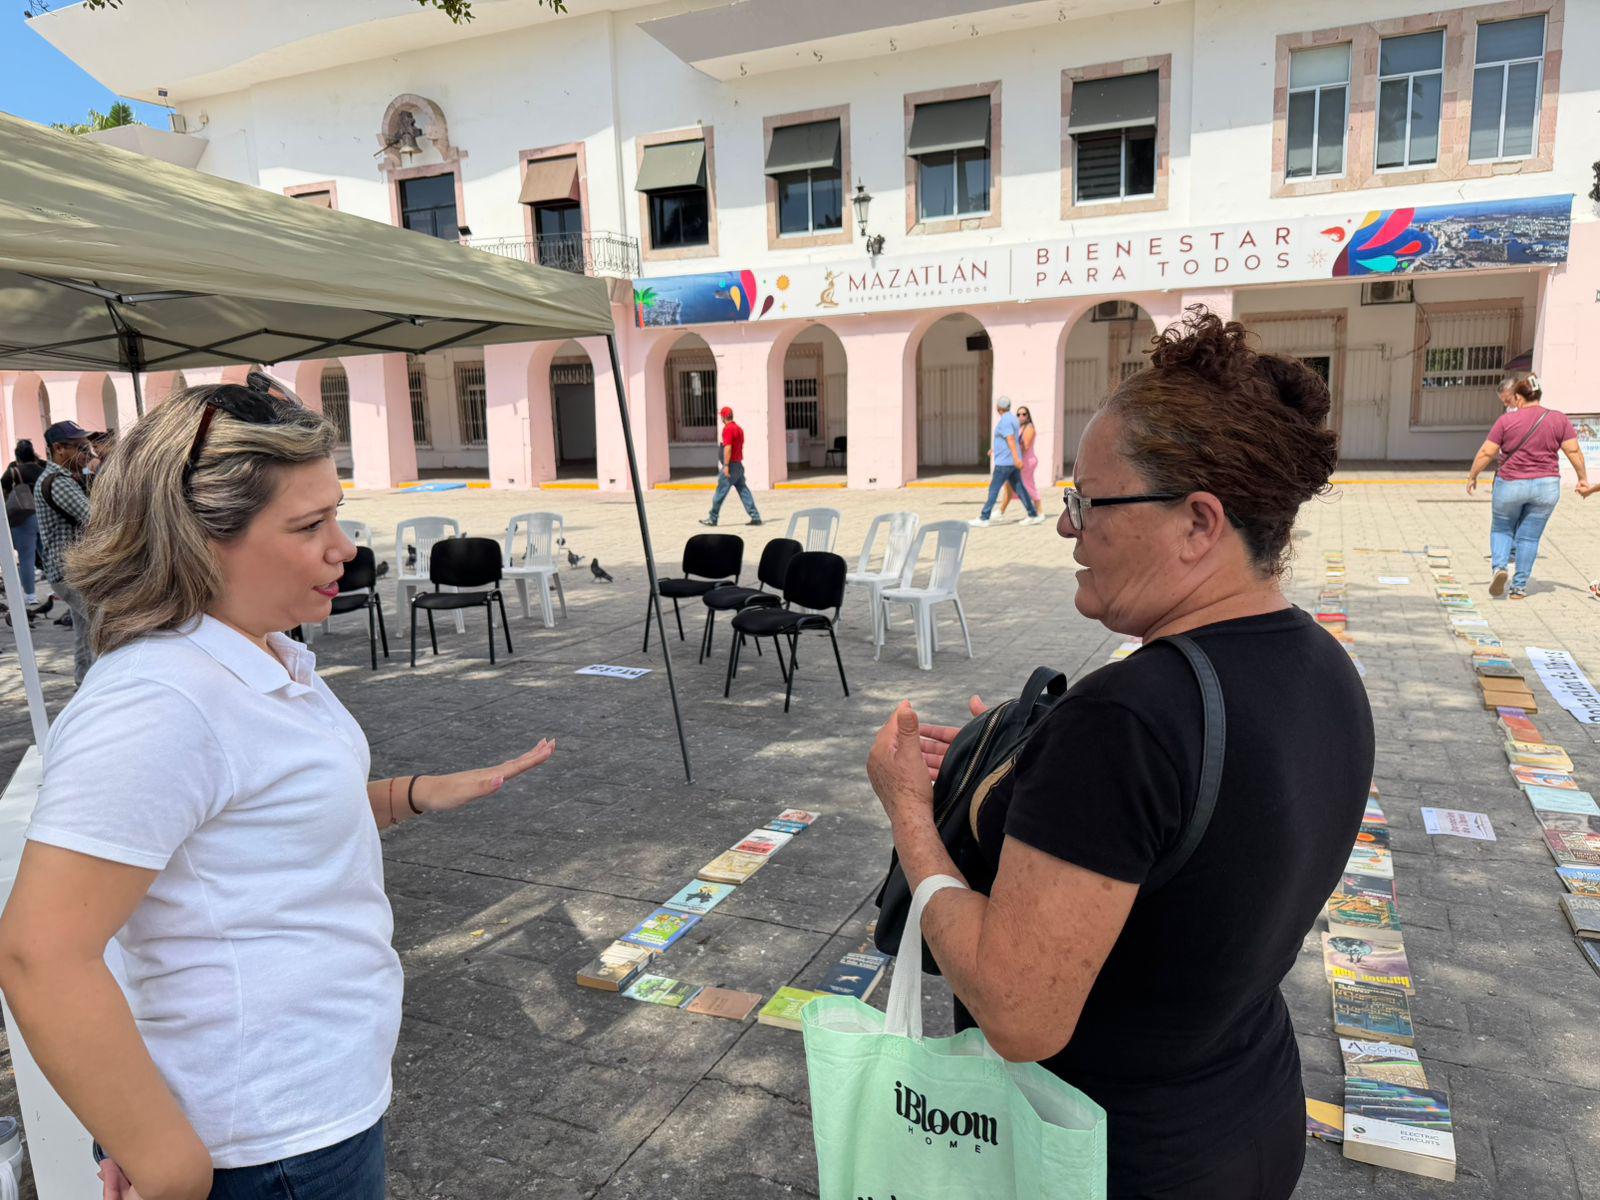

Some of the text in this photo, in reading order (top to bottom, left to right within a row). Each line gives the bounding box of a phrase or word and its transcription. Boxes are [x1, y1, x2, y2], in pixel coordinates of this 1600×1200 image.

[1036, 227, 1290, 265] BIENESTAR
[849, 257, 988, 291] MAZATLÁN
[1036, 252, 1289, 287] PARA TODOS
[849, 285, 988, 303] BIENESTAR PARA TODOS
[894, 1080, 999, 1146] iBloom
[907, 1125, 981, 1154] HOME
[1400, 1130, 1440, 1141] ELECTRIC
[1400, 1135, 1441, 1147] CIRCUITS
